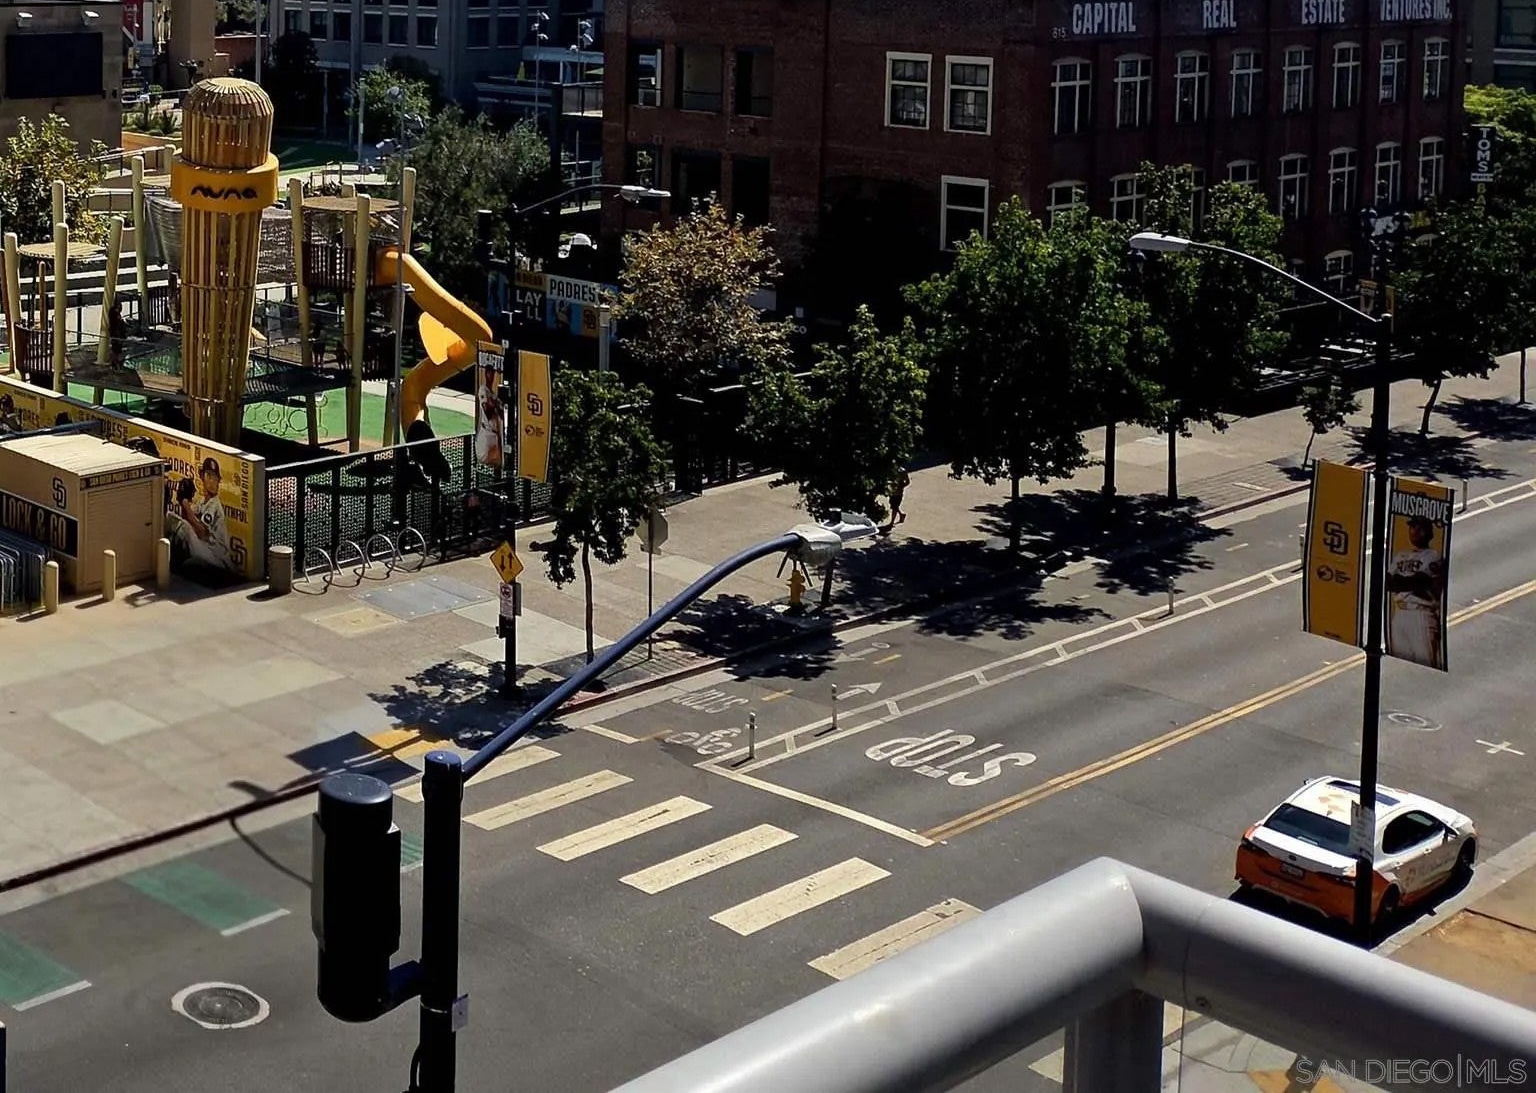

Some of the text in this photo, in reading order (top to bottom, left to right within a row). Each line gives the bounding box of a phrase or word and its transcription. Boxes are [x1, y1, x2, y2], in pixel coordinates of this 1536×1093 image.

[1072, 1, 1137, 35] CAPITAL
[1477, 127, 1491, 173] TOMS
[515, 288, 543, 307] LAY
[549, 278, 596, 303] PADRES
[1, 493, 67, 550] LOCK & GO
[222, 504, 249, 527] ITHFUL
[1391, 491, 1450, 524] MUSGROVE
[1323, 520, 1349, 556] SD
[864, 728, 1037, 787] STOP
